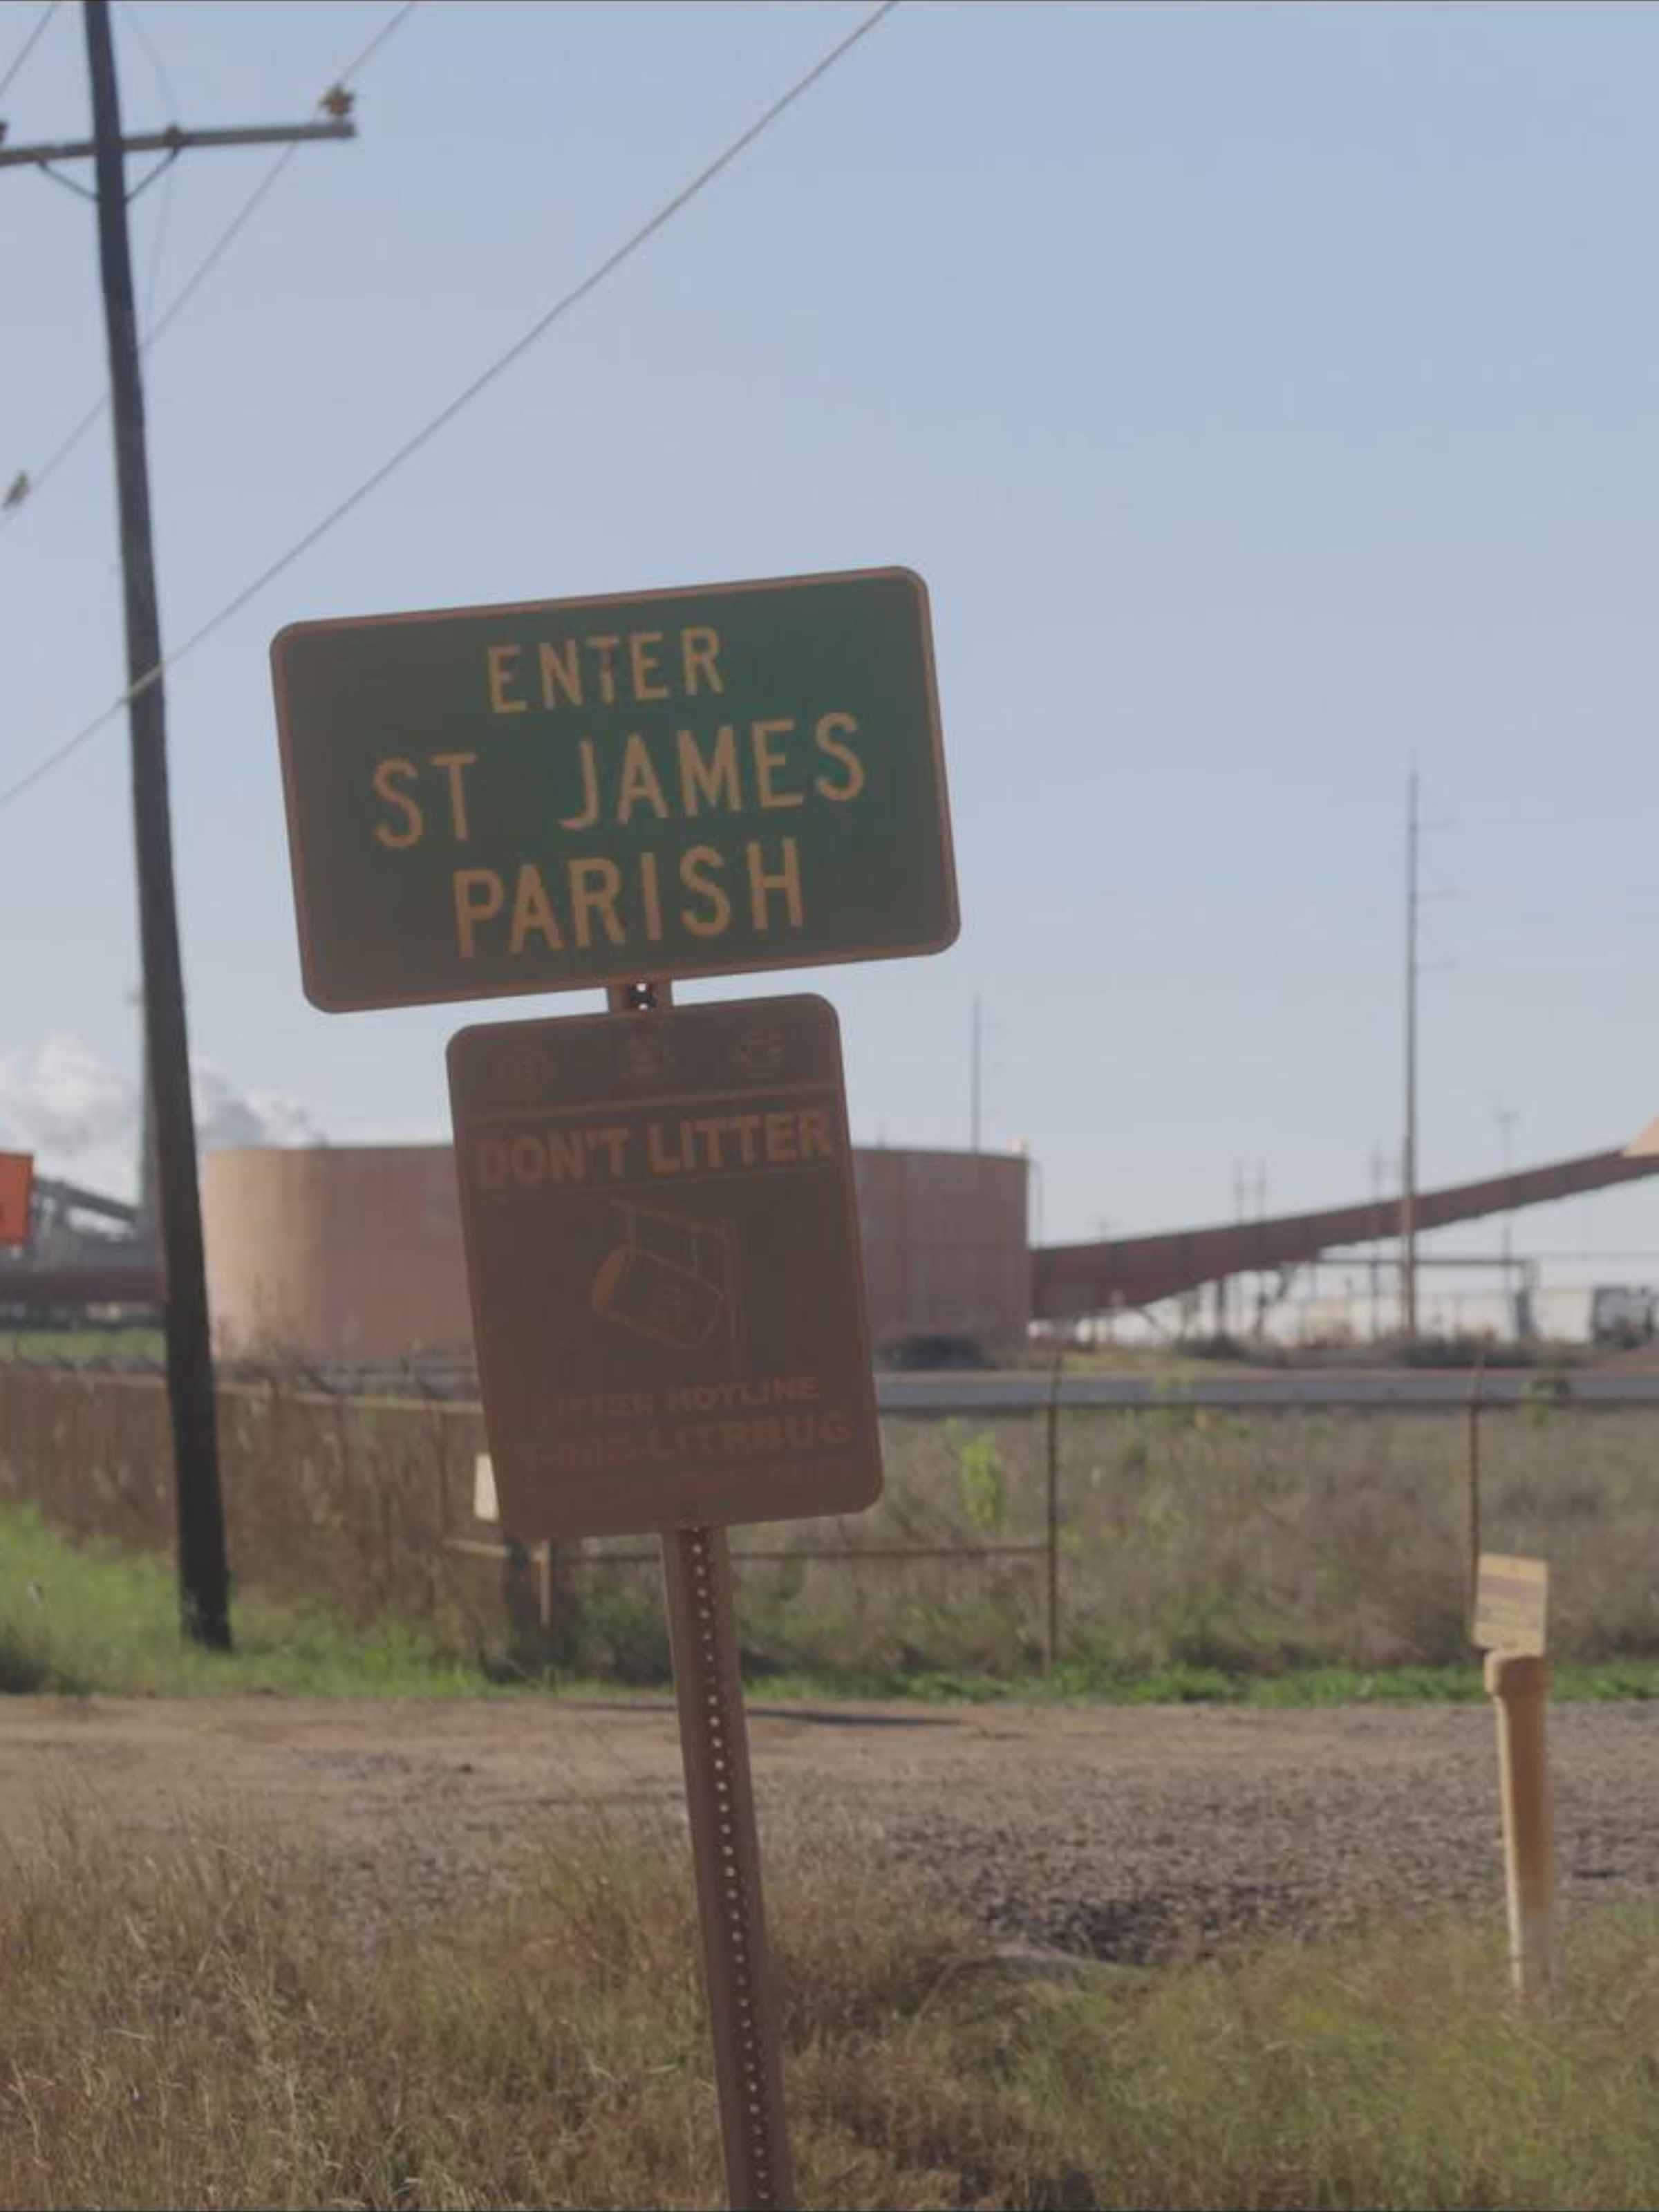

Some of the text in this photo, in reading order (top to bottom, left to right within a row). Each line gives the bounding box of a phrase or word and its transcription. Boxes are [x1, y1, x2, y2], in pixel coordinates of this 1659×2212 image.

[487, 626, 724, 715] ENTER
[372, 712, 866, 850] ST JAMES
[452, 838, 805, 958] PARISH
[478, 1111, 834, 1185] DON'T LITTER
[666, 1376, 821, 1413] HOTLINE
